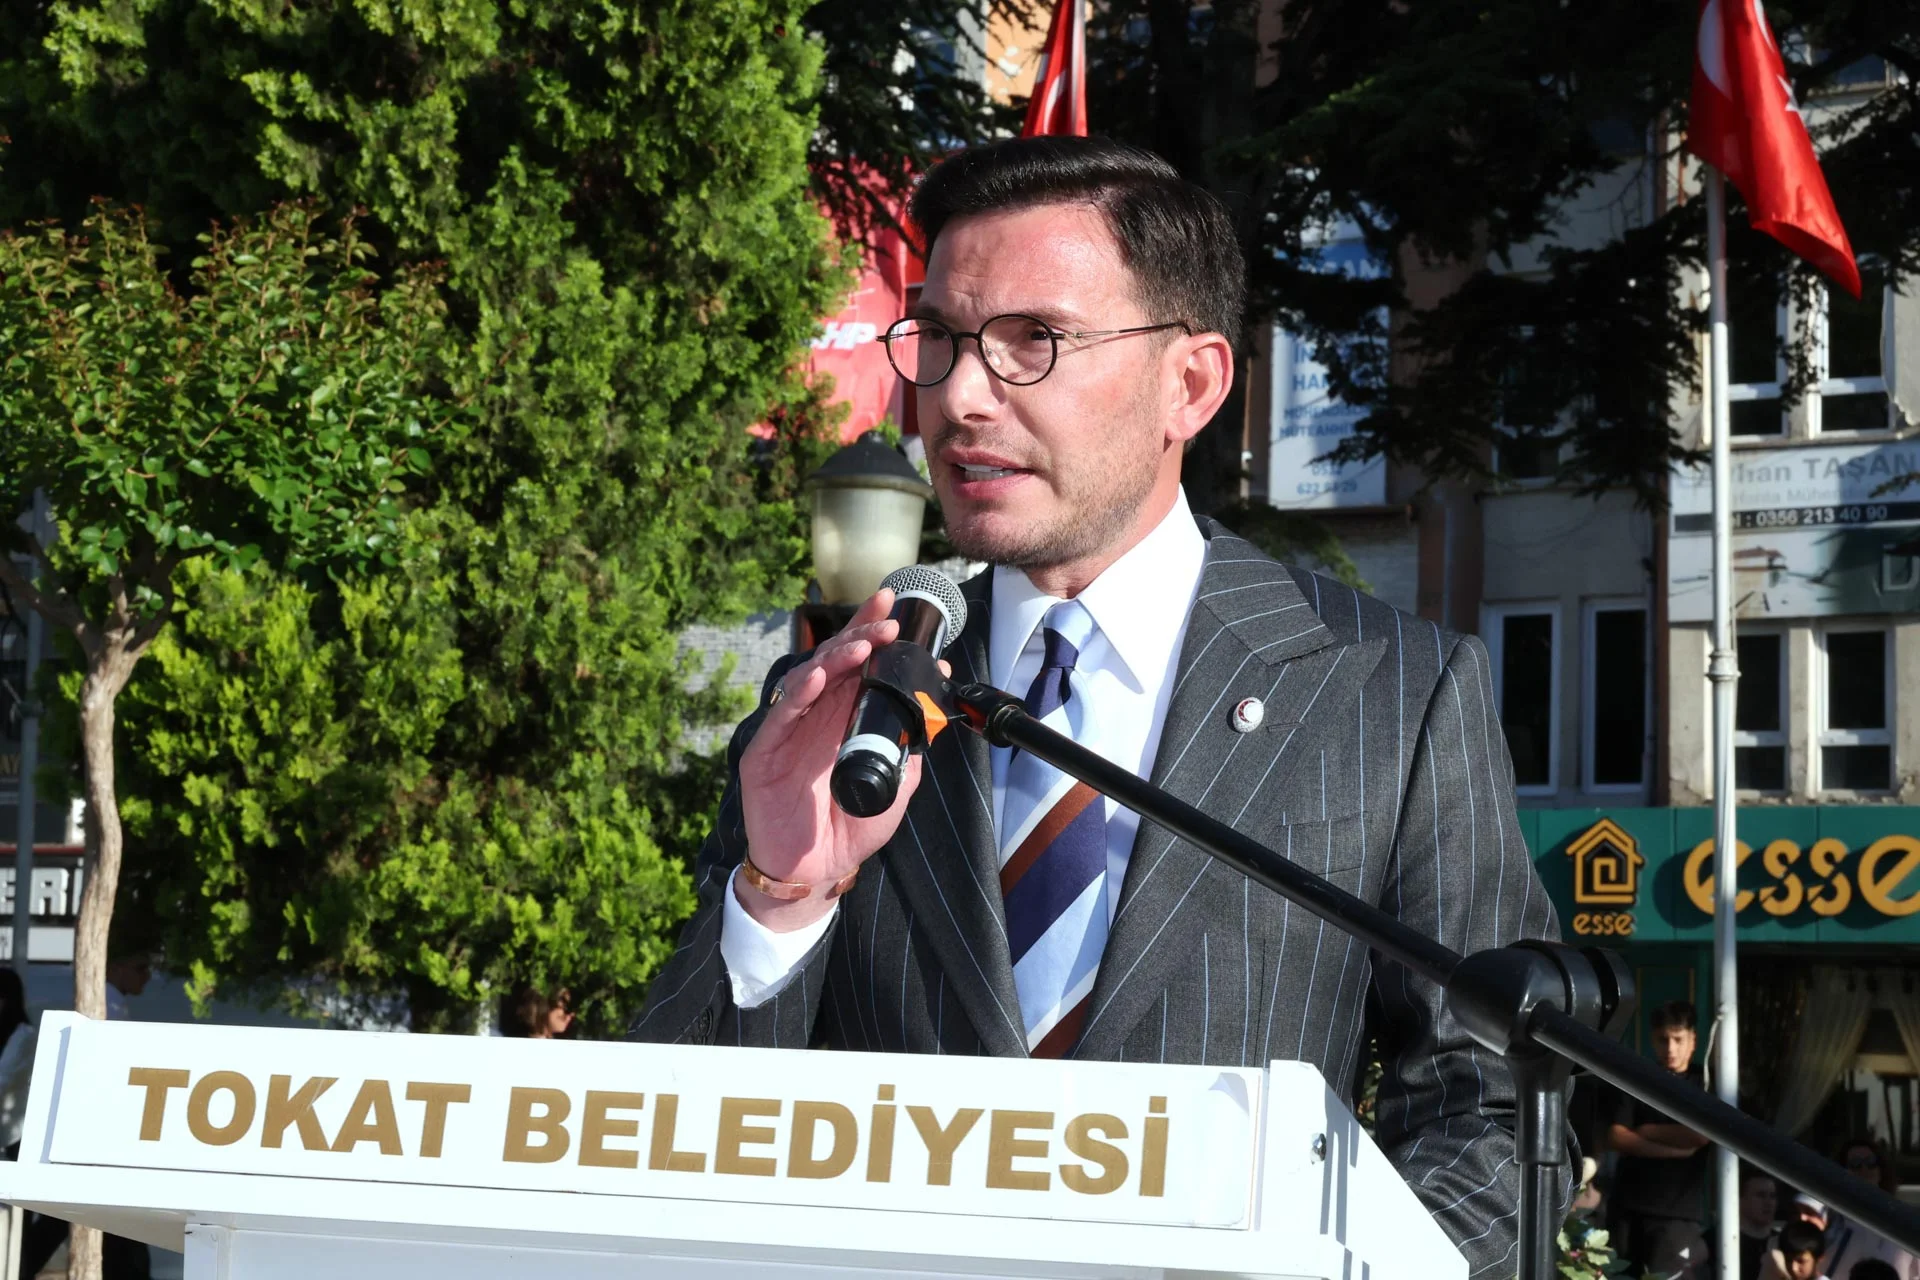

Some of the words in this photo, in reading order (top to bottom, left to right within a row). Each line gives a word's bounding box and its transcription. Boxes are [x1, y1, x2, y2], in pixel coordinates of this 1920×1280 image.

[1756, 510, 1798, 526] 0356
[1803, 508, 1836, 524] 213
[1839, 506, 1861, 522] 40
[1683, 834, 1920, 917] esse
[1572, 912, 1635, 936] esse
[128, 1066, 472, 1159] TOKAT
[502, 1083, 1169, 1198] BELEDİYESİ
